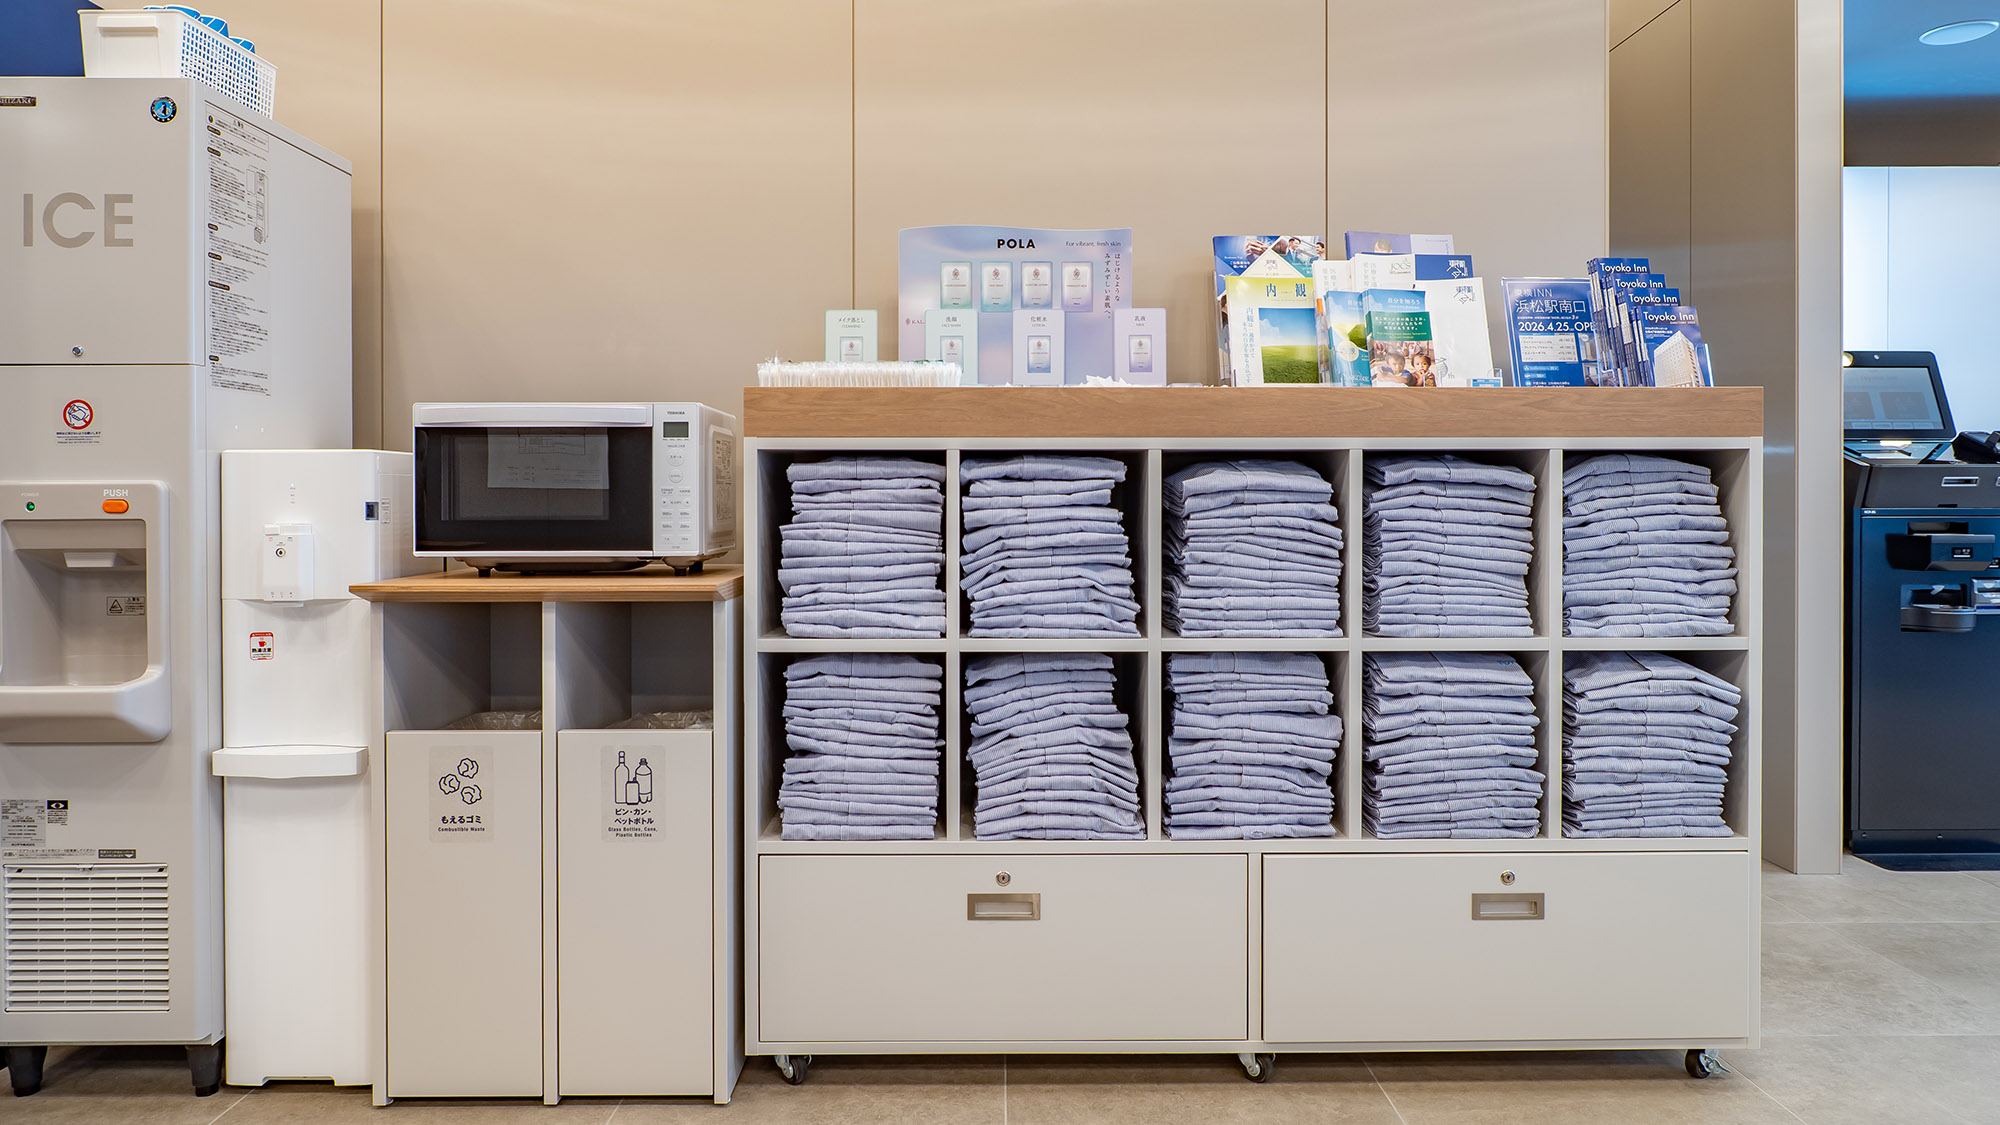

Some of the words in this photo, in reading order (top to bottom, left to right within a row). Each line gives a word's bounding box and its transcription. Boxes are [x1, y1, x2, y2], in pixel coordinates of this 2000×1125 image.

[23, 192, 134, 248] ICE
[997, 239, 1036, 249] POLA
[1600, 262, 1631, 273] Toyoko
[1633, 263, 1648, 272] Inn
[1615, 278, 1647, 288] Toyoko
[1649, 279, 1664, 288] Inn
[1266, 283, 1277, 297] 内
[1295, 283, 1307, 297] 観
[1628, 293, 1661, 304] Toyoko
[1663, 294, 1678, 303] Inn
[1515, 299, 1586, 313] 浜松駅南口
[1643, 311, 1677, 323] Toyoko
[1679, 312, 1695, 321] Inn
[1518, 321, 1569, 332] 2026.4.25
[1574, 321, 1596, 332] OPE
[103, 489, 129, 497] PUSH
[441, 815, 482, 824] もえるゴミ
